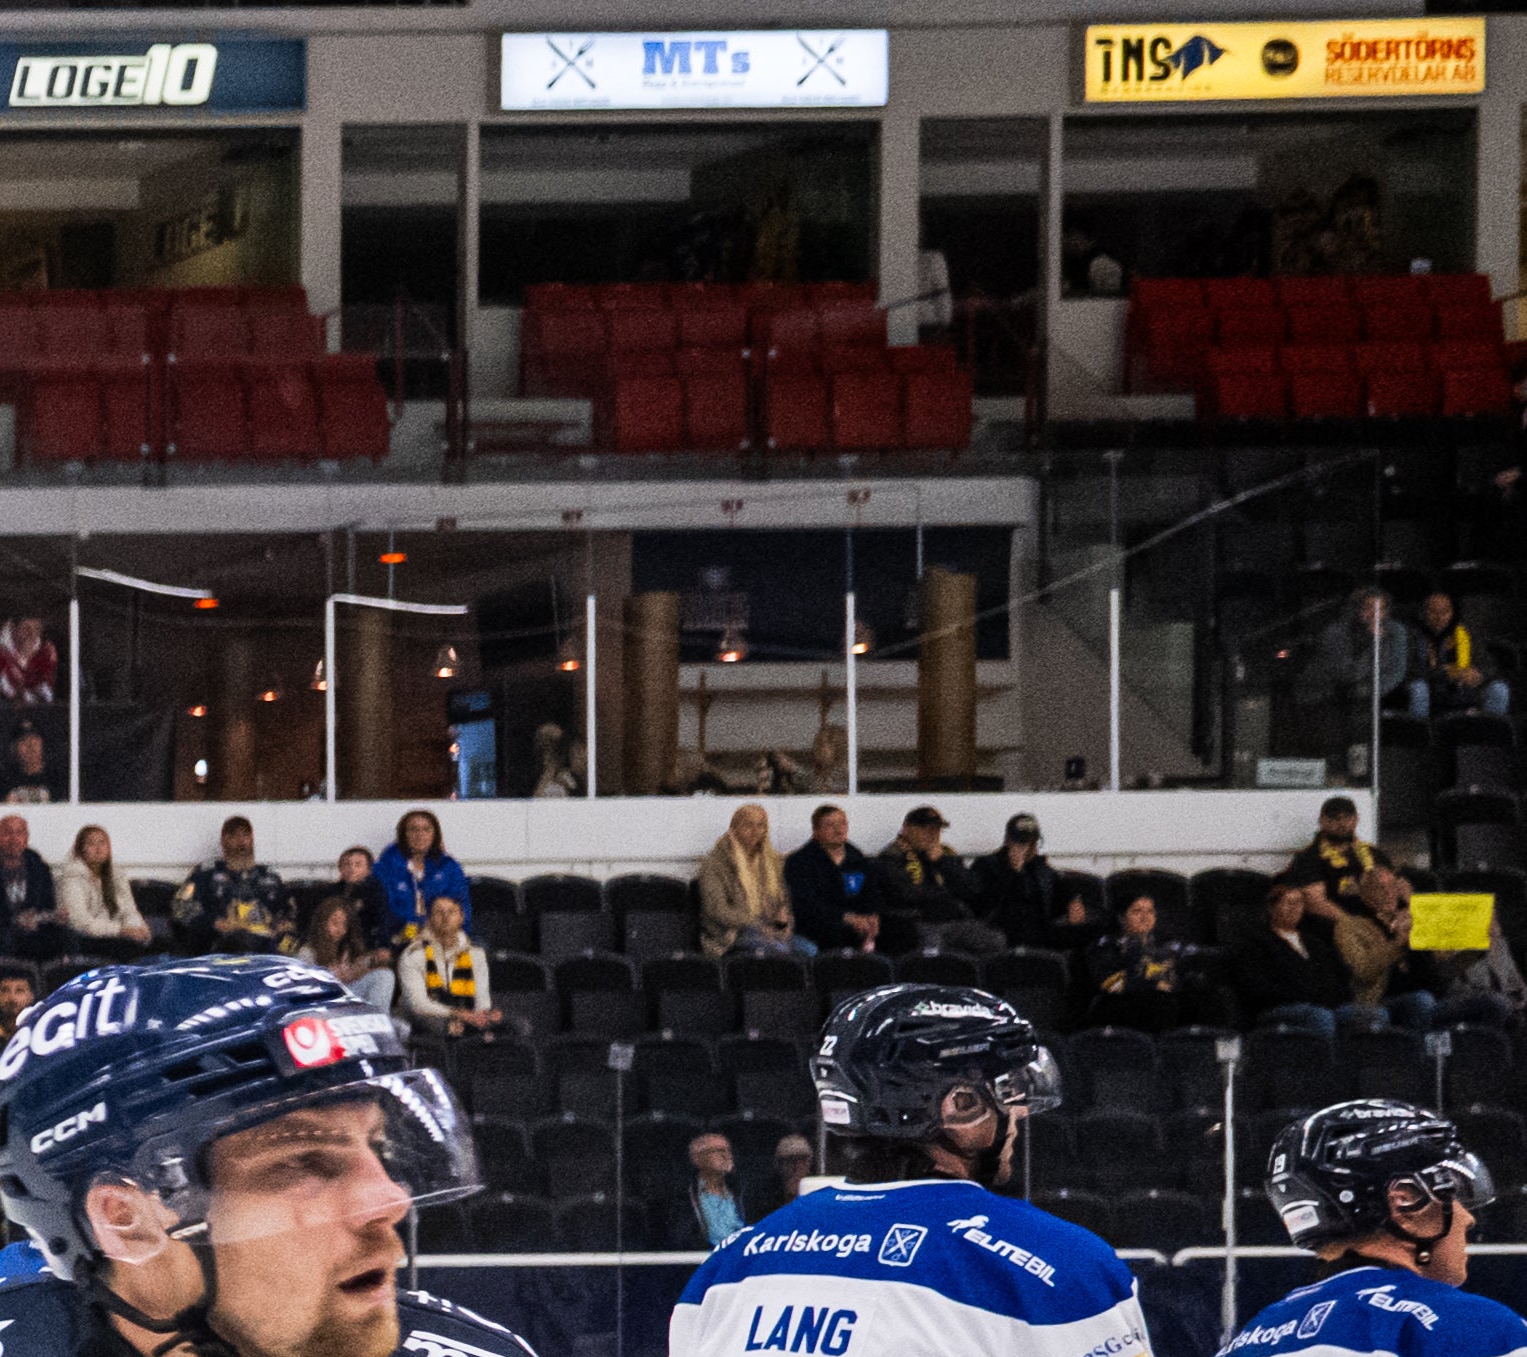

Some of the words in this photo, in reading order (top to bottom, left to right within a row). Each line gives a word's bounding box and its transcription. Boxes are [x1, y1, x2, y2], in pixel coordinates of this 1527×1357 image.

[30, 1101, 107, 1154] CCM
[743, 1228, 872, 1260] Karlskoga
[963, 1227, 1057, 1288] ELITEBIL
[744, 1304, 859, 1357] LANG
